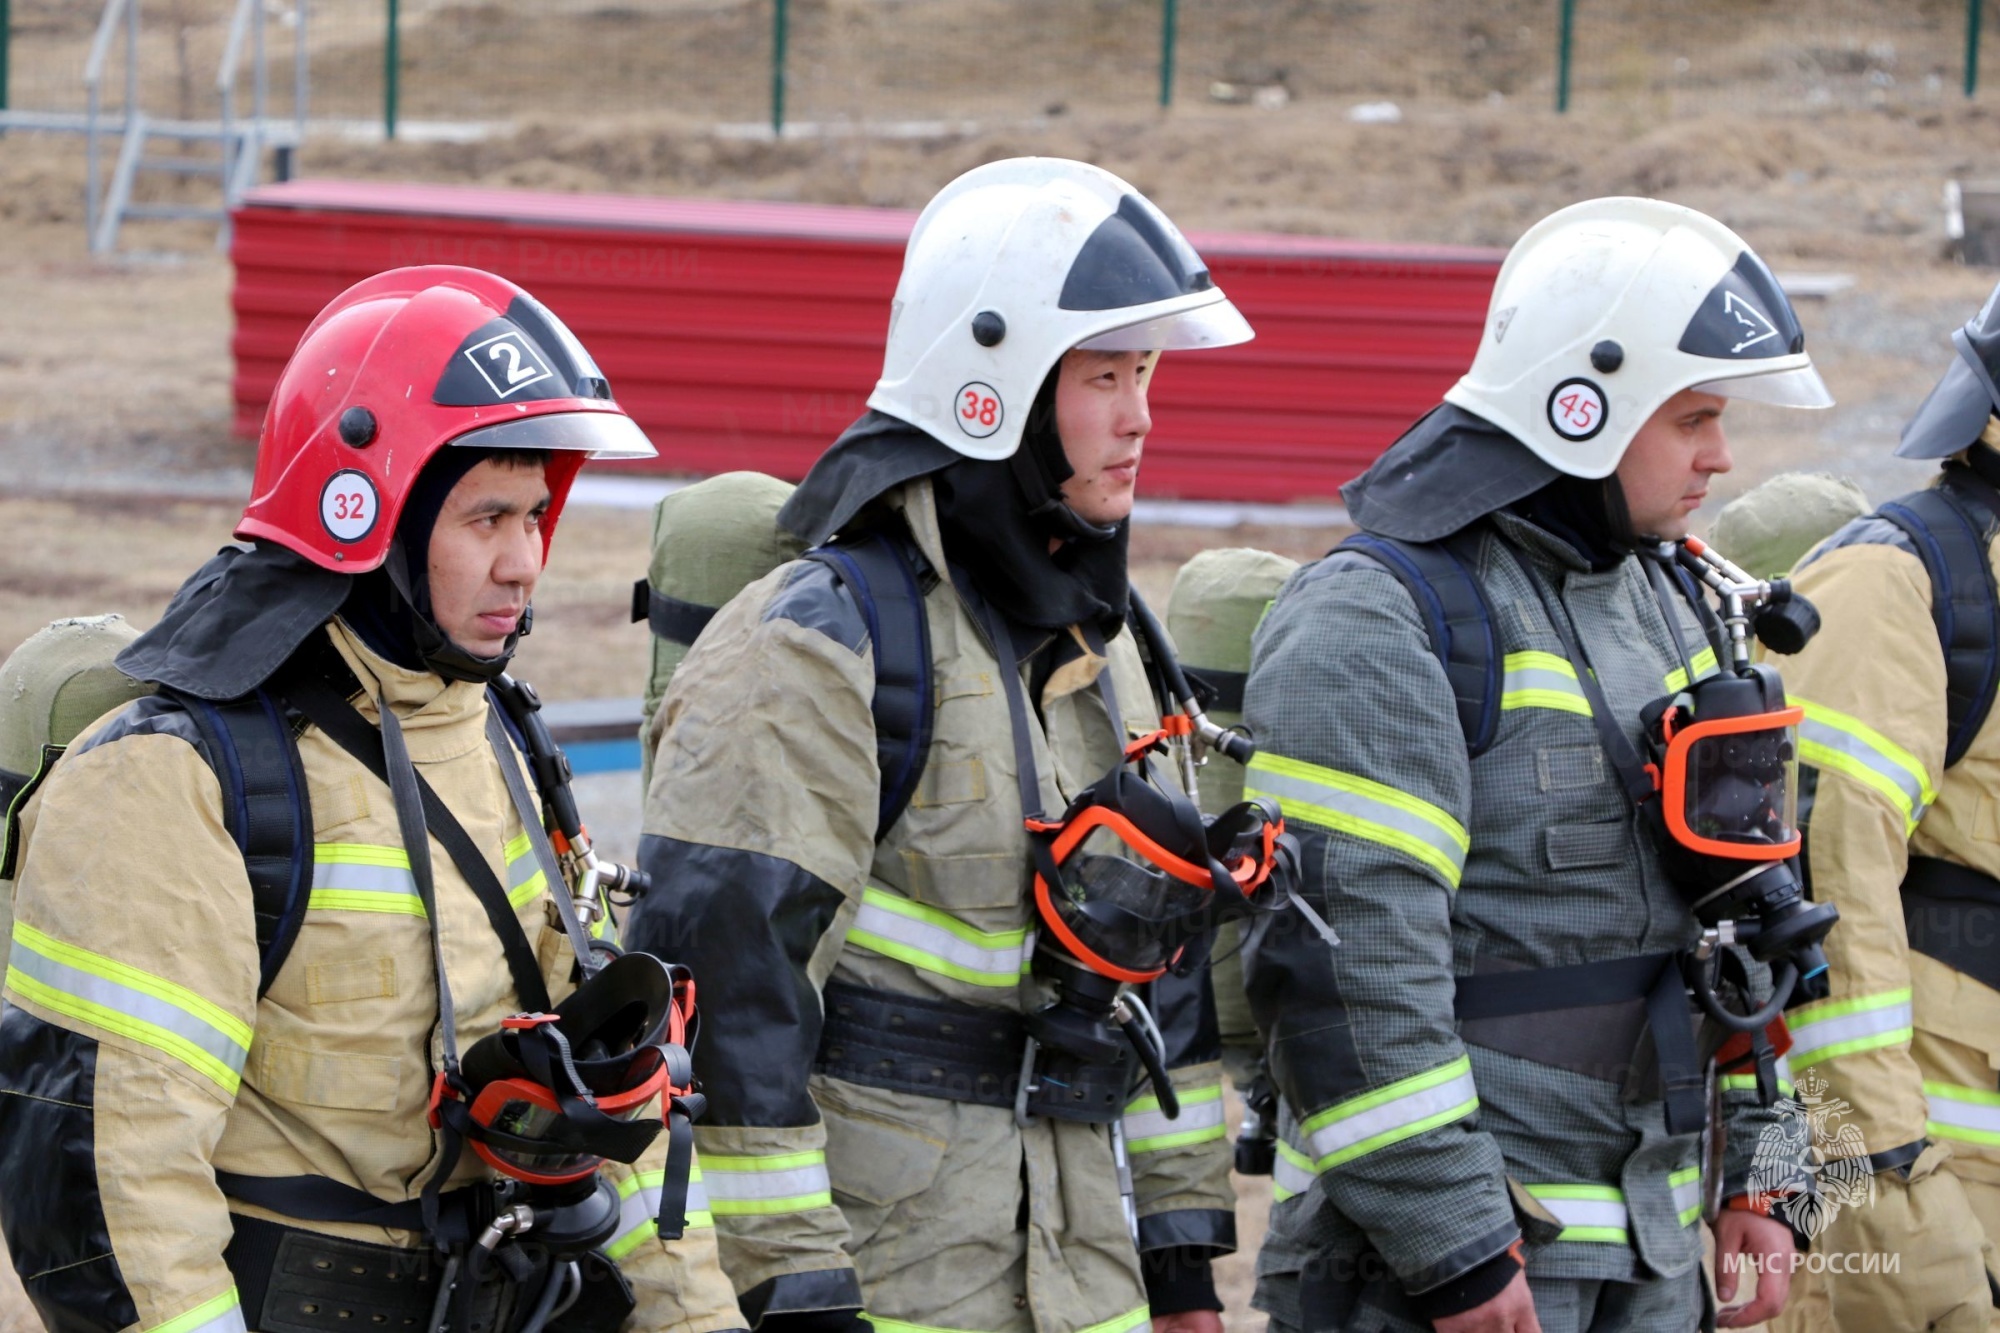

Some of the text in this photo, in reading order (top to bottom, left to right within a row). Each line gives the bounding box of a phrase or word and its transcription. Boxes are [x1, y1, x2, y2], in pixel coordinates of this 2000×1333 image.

[488, 342, 537, 385] 2
[960, 390, 998, 427] 38
[1558, 392, 1599, 428] 45
[333, 492, 365, 521] 32
